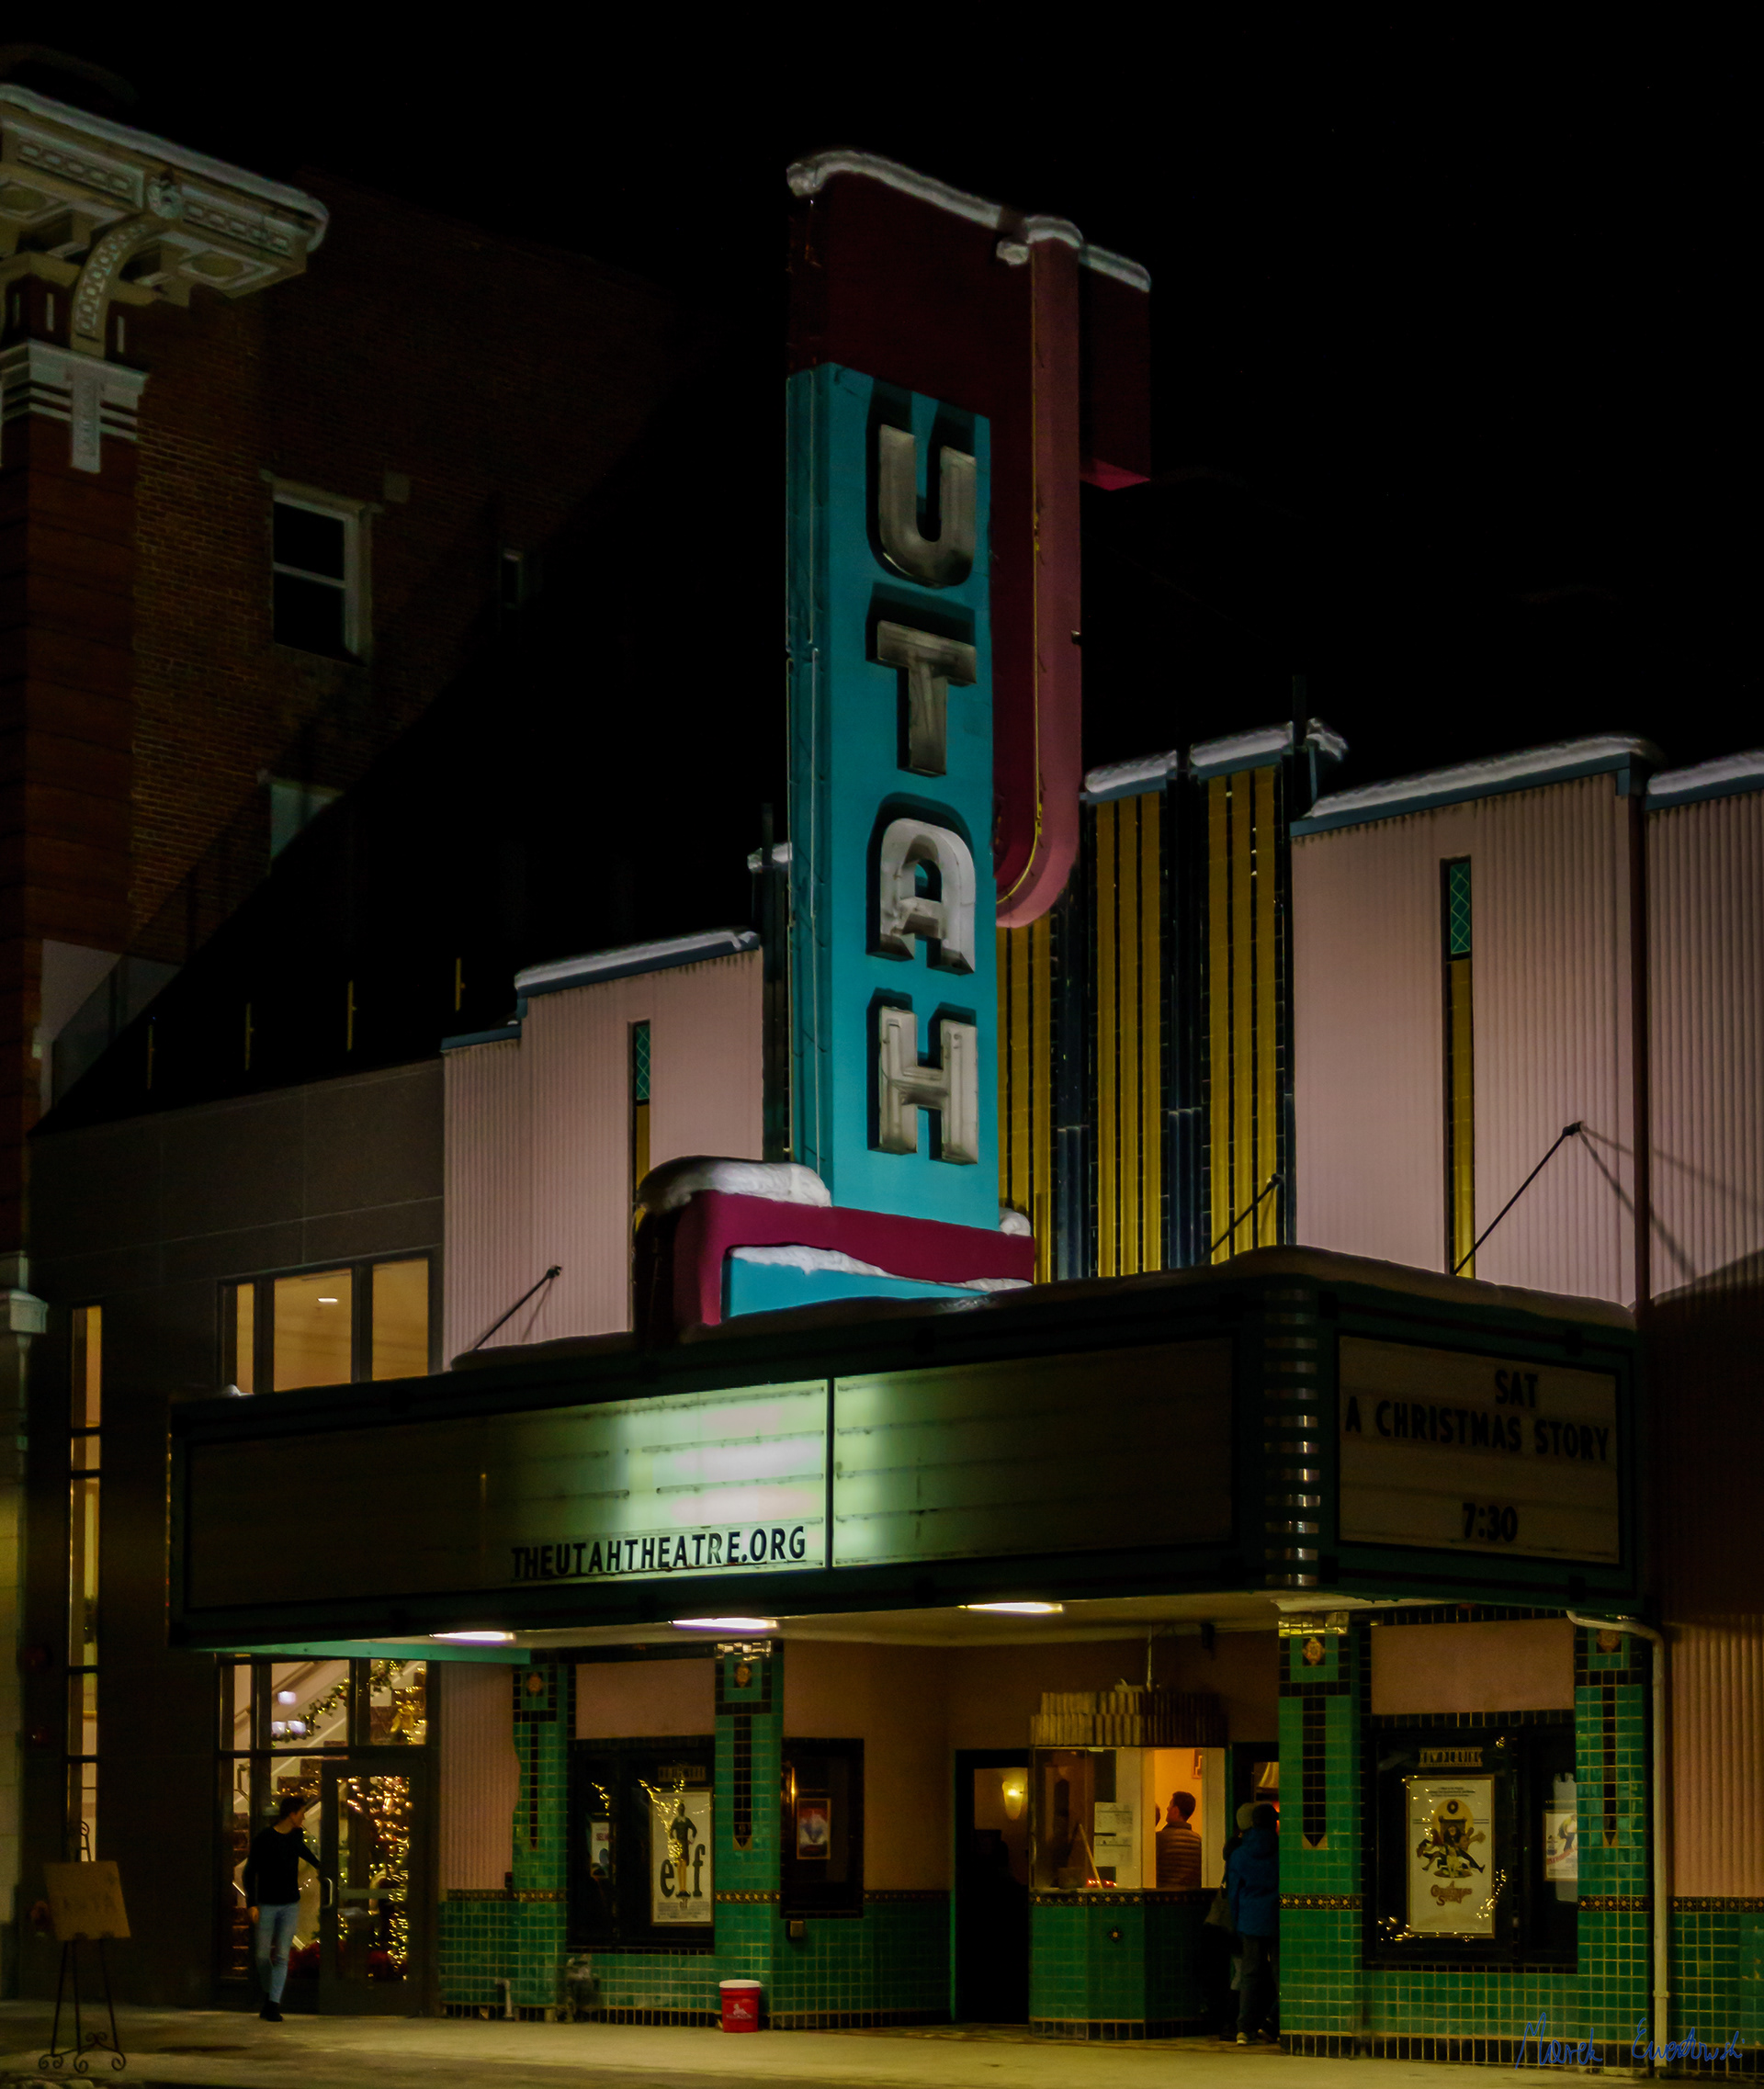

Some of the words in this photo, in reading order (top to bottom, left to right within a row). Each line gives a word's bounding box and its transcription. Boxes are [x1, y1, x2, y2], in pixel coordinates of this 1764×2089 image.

[866, 422, 979, 1165] UTAH
[1495, 1370, 1538, 1408] SAT
[1345, 1396, 1362, 1433] A
[1376, 1401, 1522, 1451] CHRISTMAS
[1534, 1419, 1609, 1461] STORY
[1463, 1503, 1518, 1542] 7:30
[511, 1525, 807, 1579] THEUTAHTHEATRE.ORG
